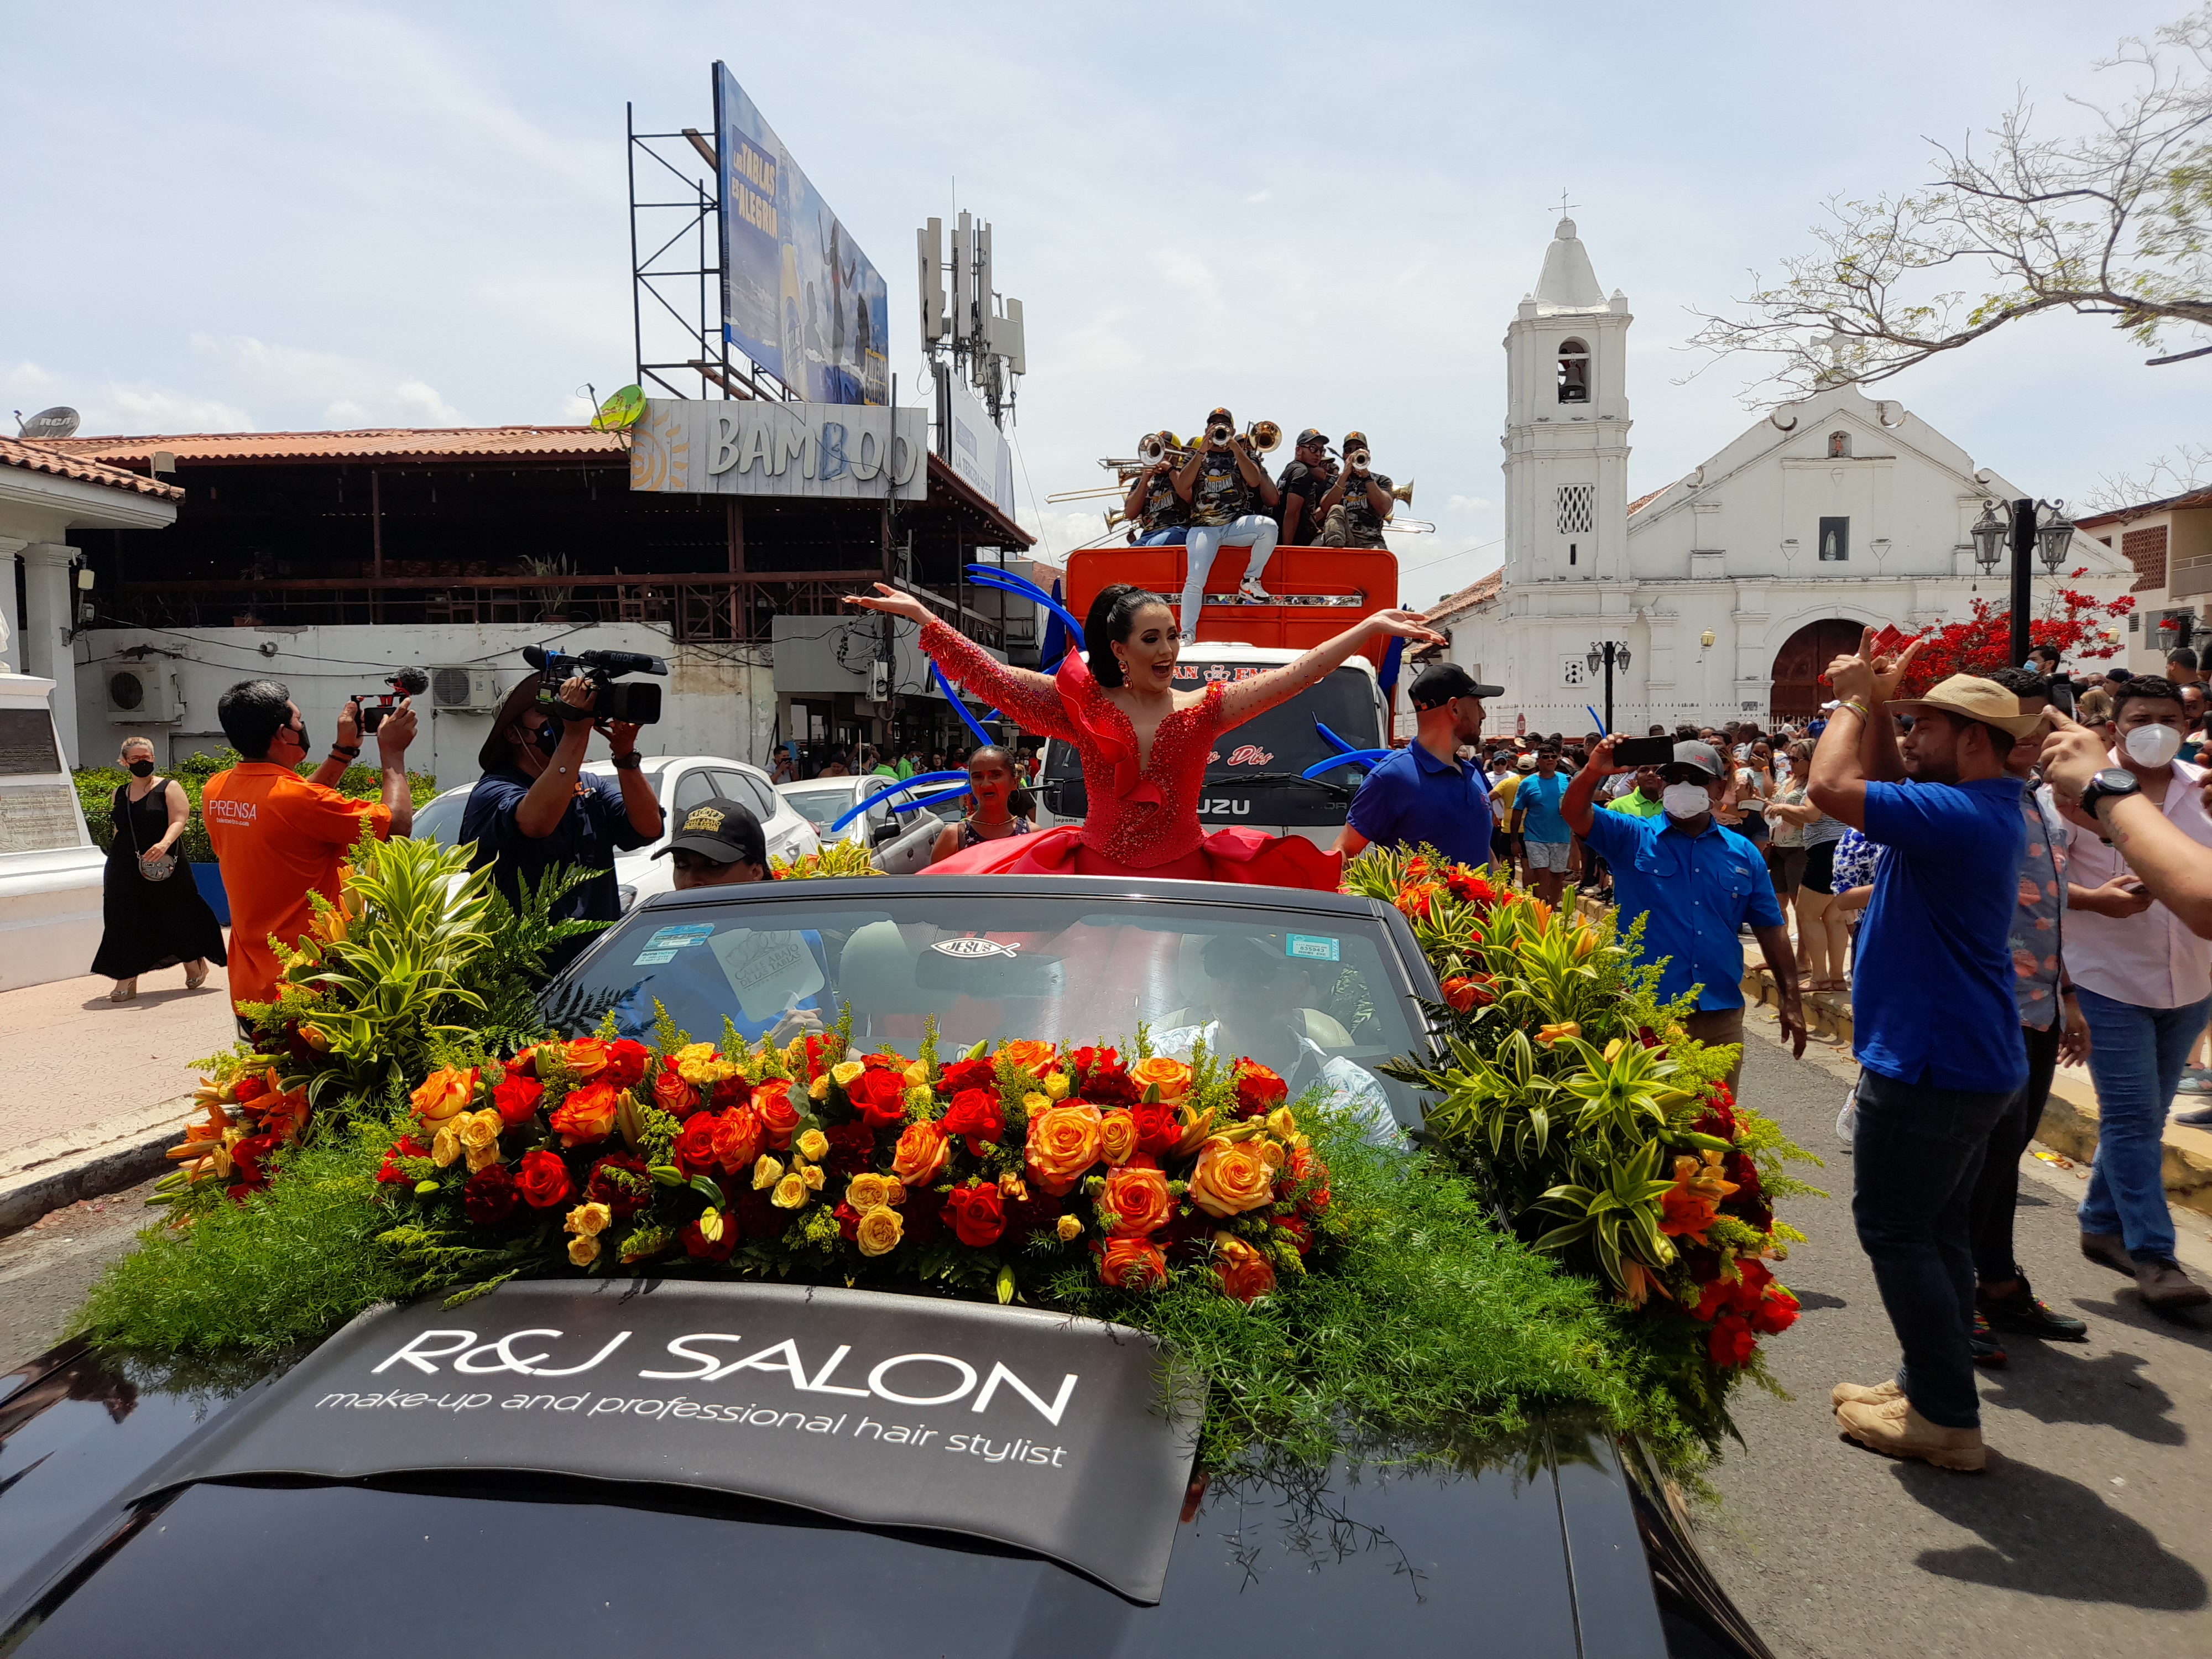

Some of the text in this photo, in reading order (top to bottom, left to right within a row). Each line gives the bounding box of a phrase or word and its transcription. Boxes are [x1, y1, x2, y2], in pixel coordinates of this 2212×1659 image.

[742, 141, 775, 197] TABLAS
[732, 176, 739, 200] ES
[39, 417, 72, 426] RCA
[708, 416, 917, 487] BAMBOO
[1204, 477, 1234, 493] SOBERANA
[209, 800, 257, 820] PRENSA
[1196, 799, 1250, 815] UZU
[946, 941, 992, 953] JESUS
[735, 944, 799, 980] CALLE ABAJO
[740, 952, 801, 987] DE LAS TABLAS
[371, 1329, 1078, 1427] R&J SALON
[315, 1389, 1067, 1468] make-up and professional hair stylist
